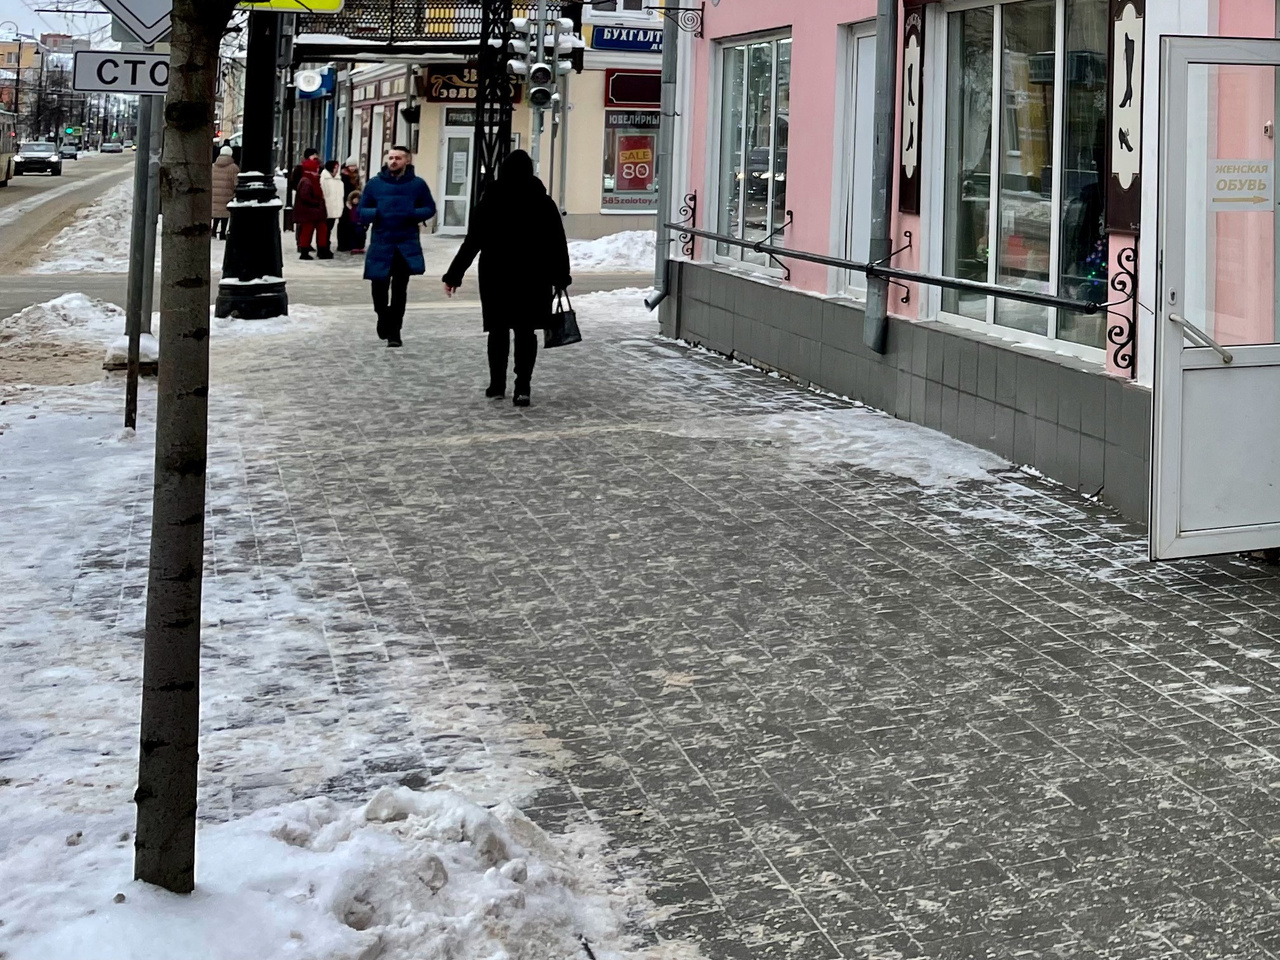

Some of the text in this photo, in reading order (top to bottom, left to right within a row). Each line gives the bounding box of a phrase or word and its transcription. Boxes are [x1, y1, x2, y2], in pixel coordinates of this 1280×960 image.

[603, 28, 663, 43] БУХГАЛТ
[96, 58, 170, 87] СТО
[609, 114, 660, 125] ЮВЕЛИРНЫ
[620, 150, 650, 161] SALE
[1215, 164, 1268, 174] ЖЕНСКАЯ
[1216, 178, 1267, 191] ОБУВЬ
